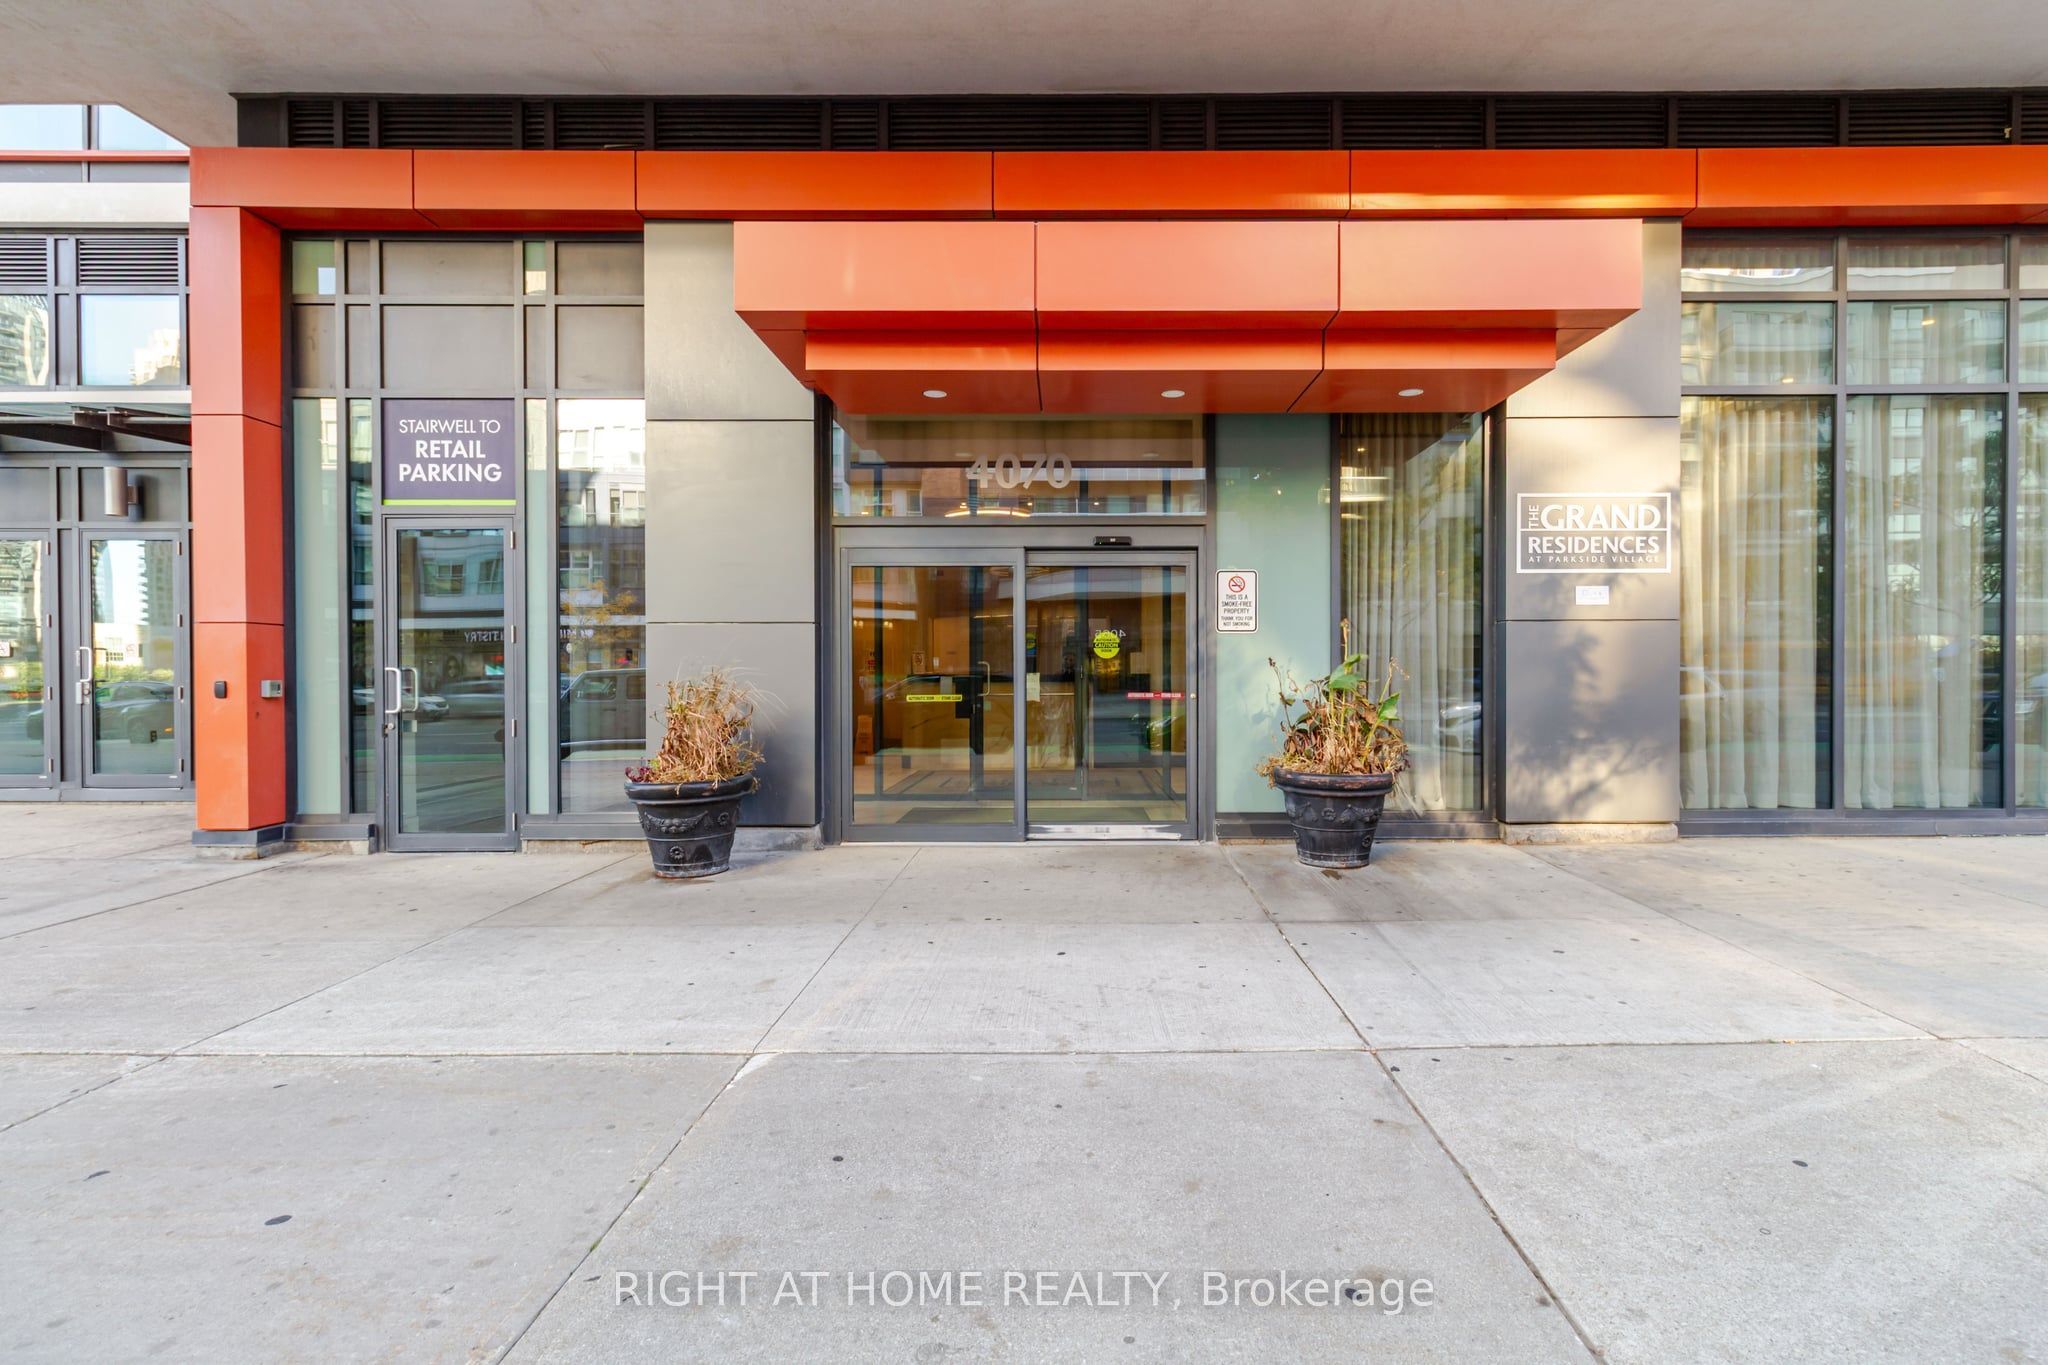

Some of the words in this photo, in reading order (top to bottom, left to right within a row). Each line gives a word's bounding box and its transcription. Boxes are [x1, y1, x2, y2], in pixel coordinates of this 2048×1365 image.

[399, 419, 477, 433] STAIRWELL
[479, 419, 501, 433] TO
[415, 440, 486, 458] RETAIL
[399, 463, 502, 482] PARKING
[965, 453, 1072, 489] 4070
[1528, 504, 1539, 529] THE
[1540, 504, 1661, 529] GRAND
[1528, 536, 1660, 554] RESIDENCES
[1528, 555, 1542, 563] AT
[1548, 555, 1605, 563] PARKSIDE
[1611, 555, 1660, 563] VILLAGE
